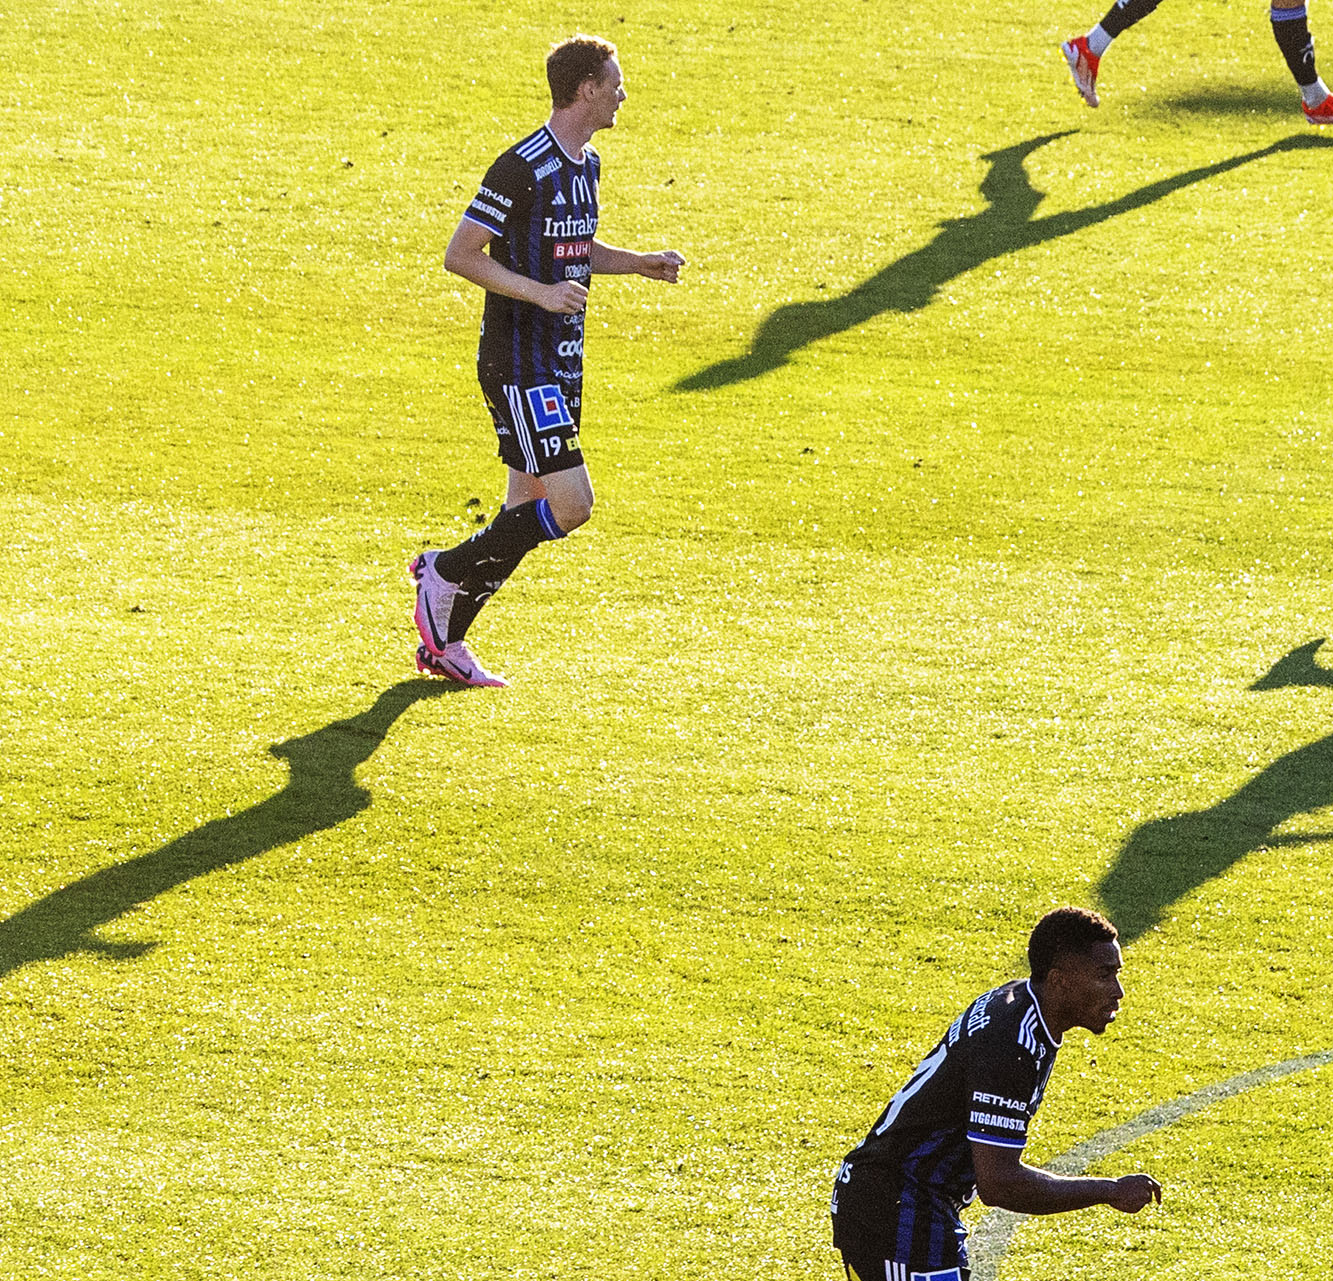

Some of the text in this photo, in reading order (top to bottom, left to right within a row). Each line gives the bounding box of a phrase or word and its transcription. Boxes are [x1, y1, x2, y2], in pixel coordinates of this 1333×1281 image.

[479, 186, 513, 208] ETHAB
[540, 436, 562, 457] 19
[972, 1090, 1027, 1111] RETHAB
